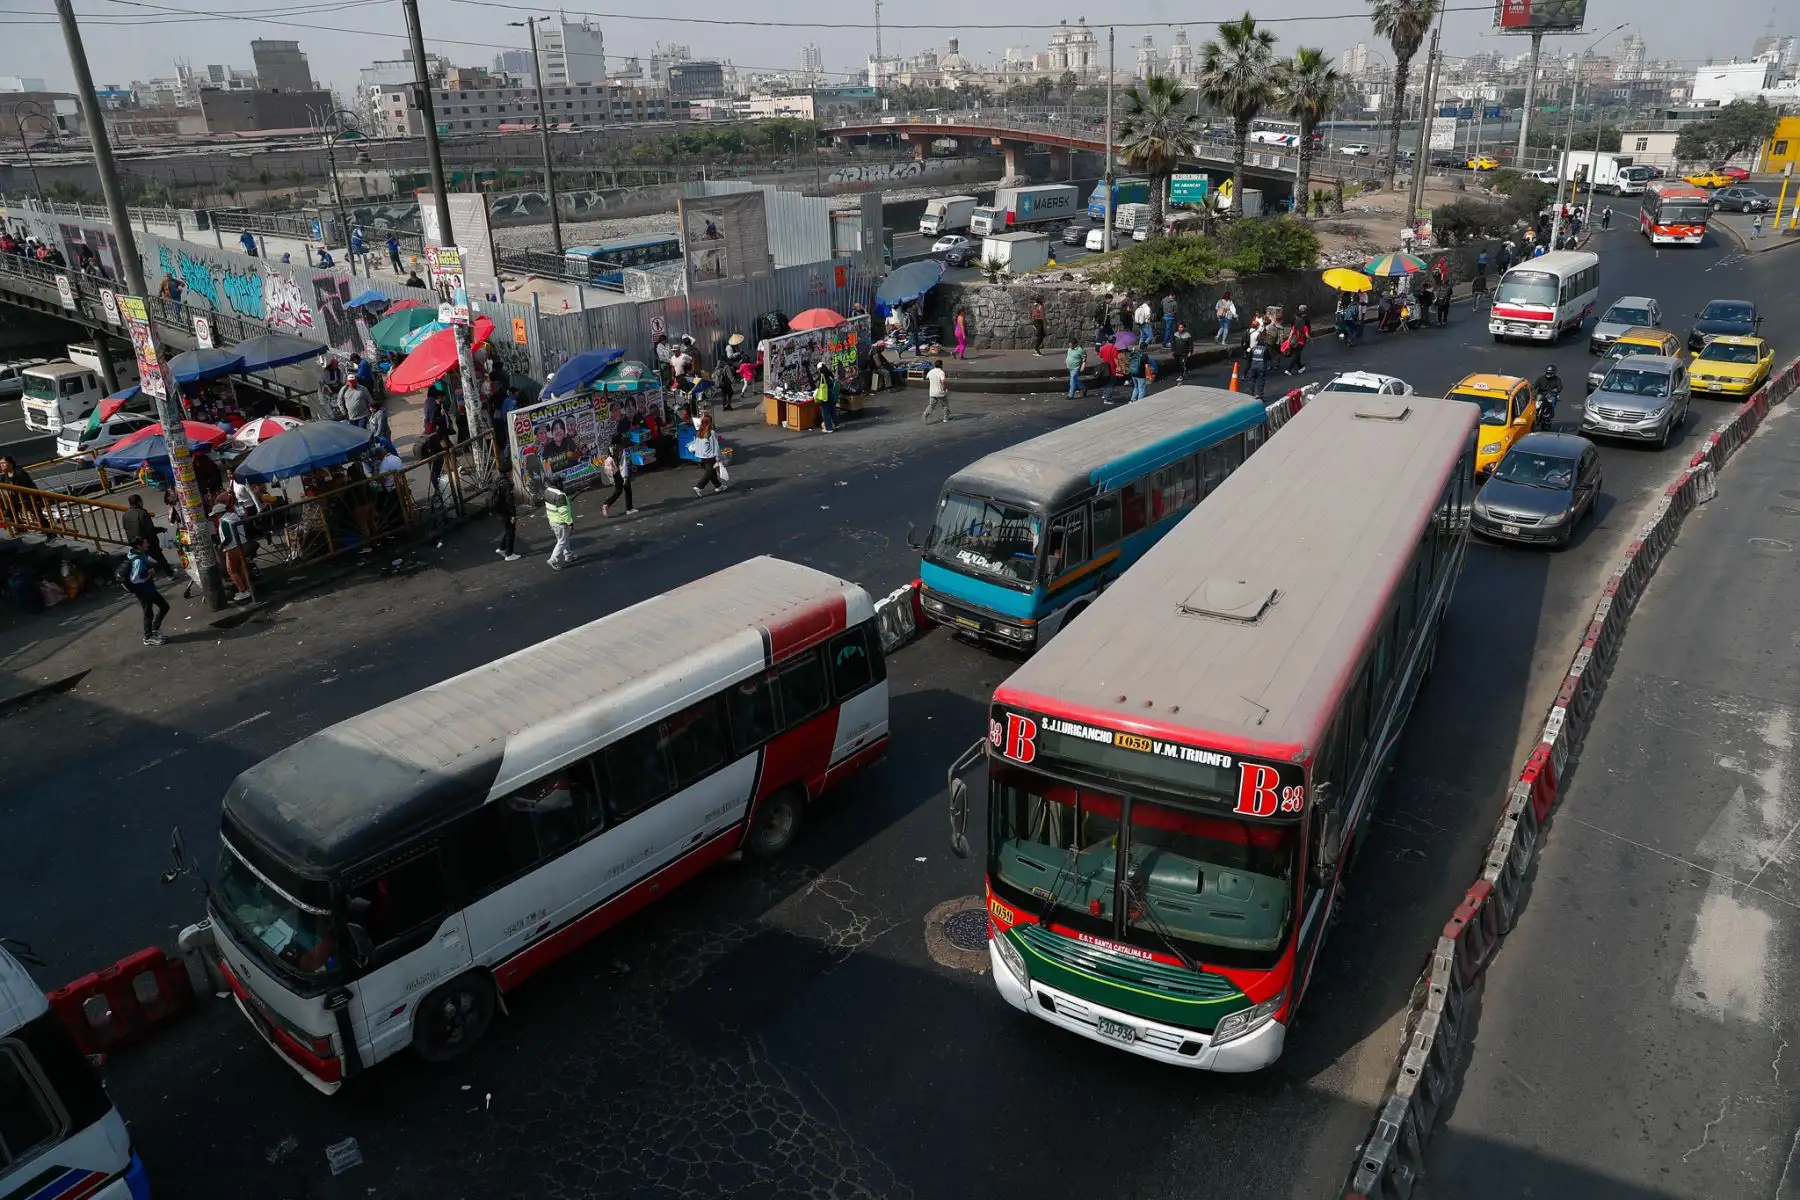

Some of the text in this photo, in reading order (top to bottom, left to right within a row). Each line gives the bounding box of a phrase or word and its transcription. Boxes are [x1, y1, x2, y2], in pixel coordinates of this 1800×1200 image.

[1034, 196, 1069, 210] MAERSK
[531, 404, 565, 422] SANTA
[565, 397, 591, 412] ROSA
[514, 418, 532, 435] 29
[1003, 711, 1037, 764] B
[1116, 734, 1150, 751] 1059
[1233, 762, 1304, 817] B 23
[991, 899, 1013, 924] 1059
[1094, 938, 1113, 950] SANTA
[1113, 944, 1141, 958] CATALINA
